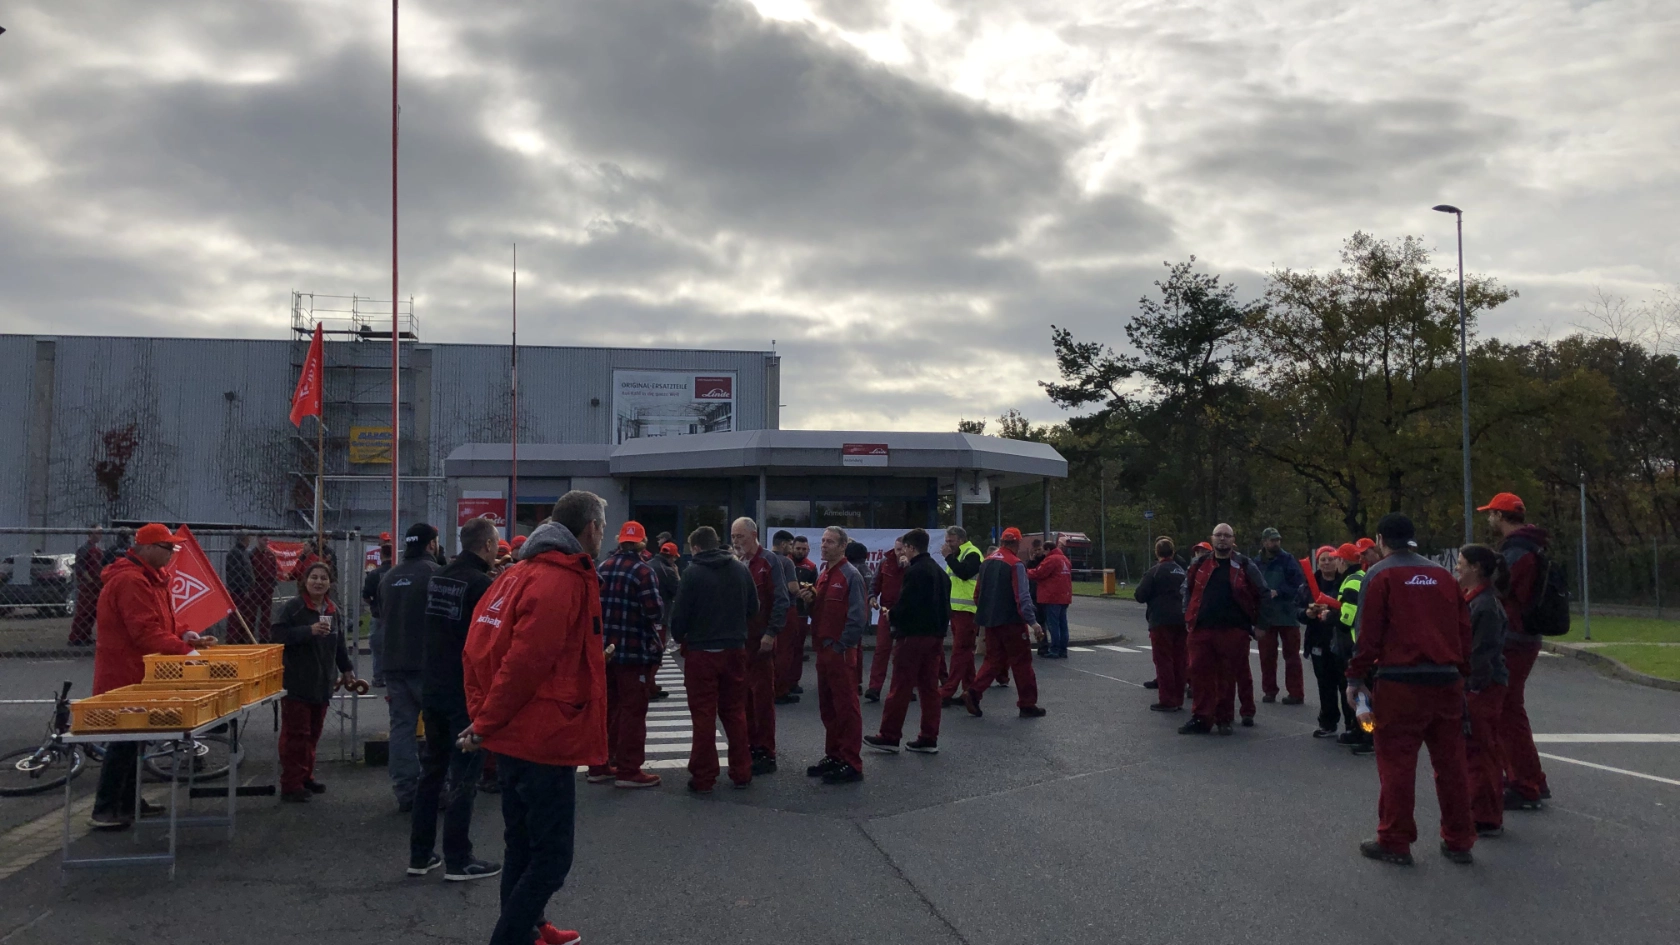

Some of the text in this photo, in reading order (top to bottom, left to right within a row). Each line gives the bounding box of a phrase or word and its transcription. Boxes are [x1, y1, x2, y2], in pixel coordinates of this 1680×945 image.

[701, 387, 730, 398] Linde
[823, 510, 861, 518] Anmeldung
[1404, 574, 1438, 586] Linde
